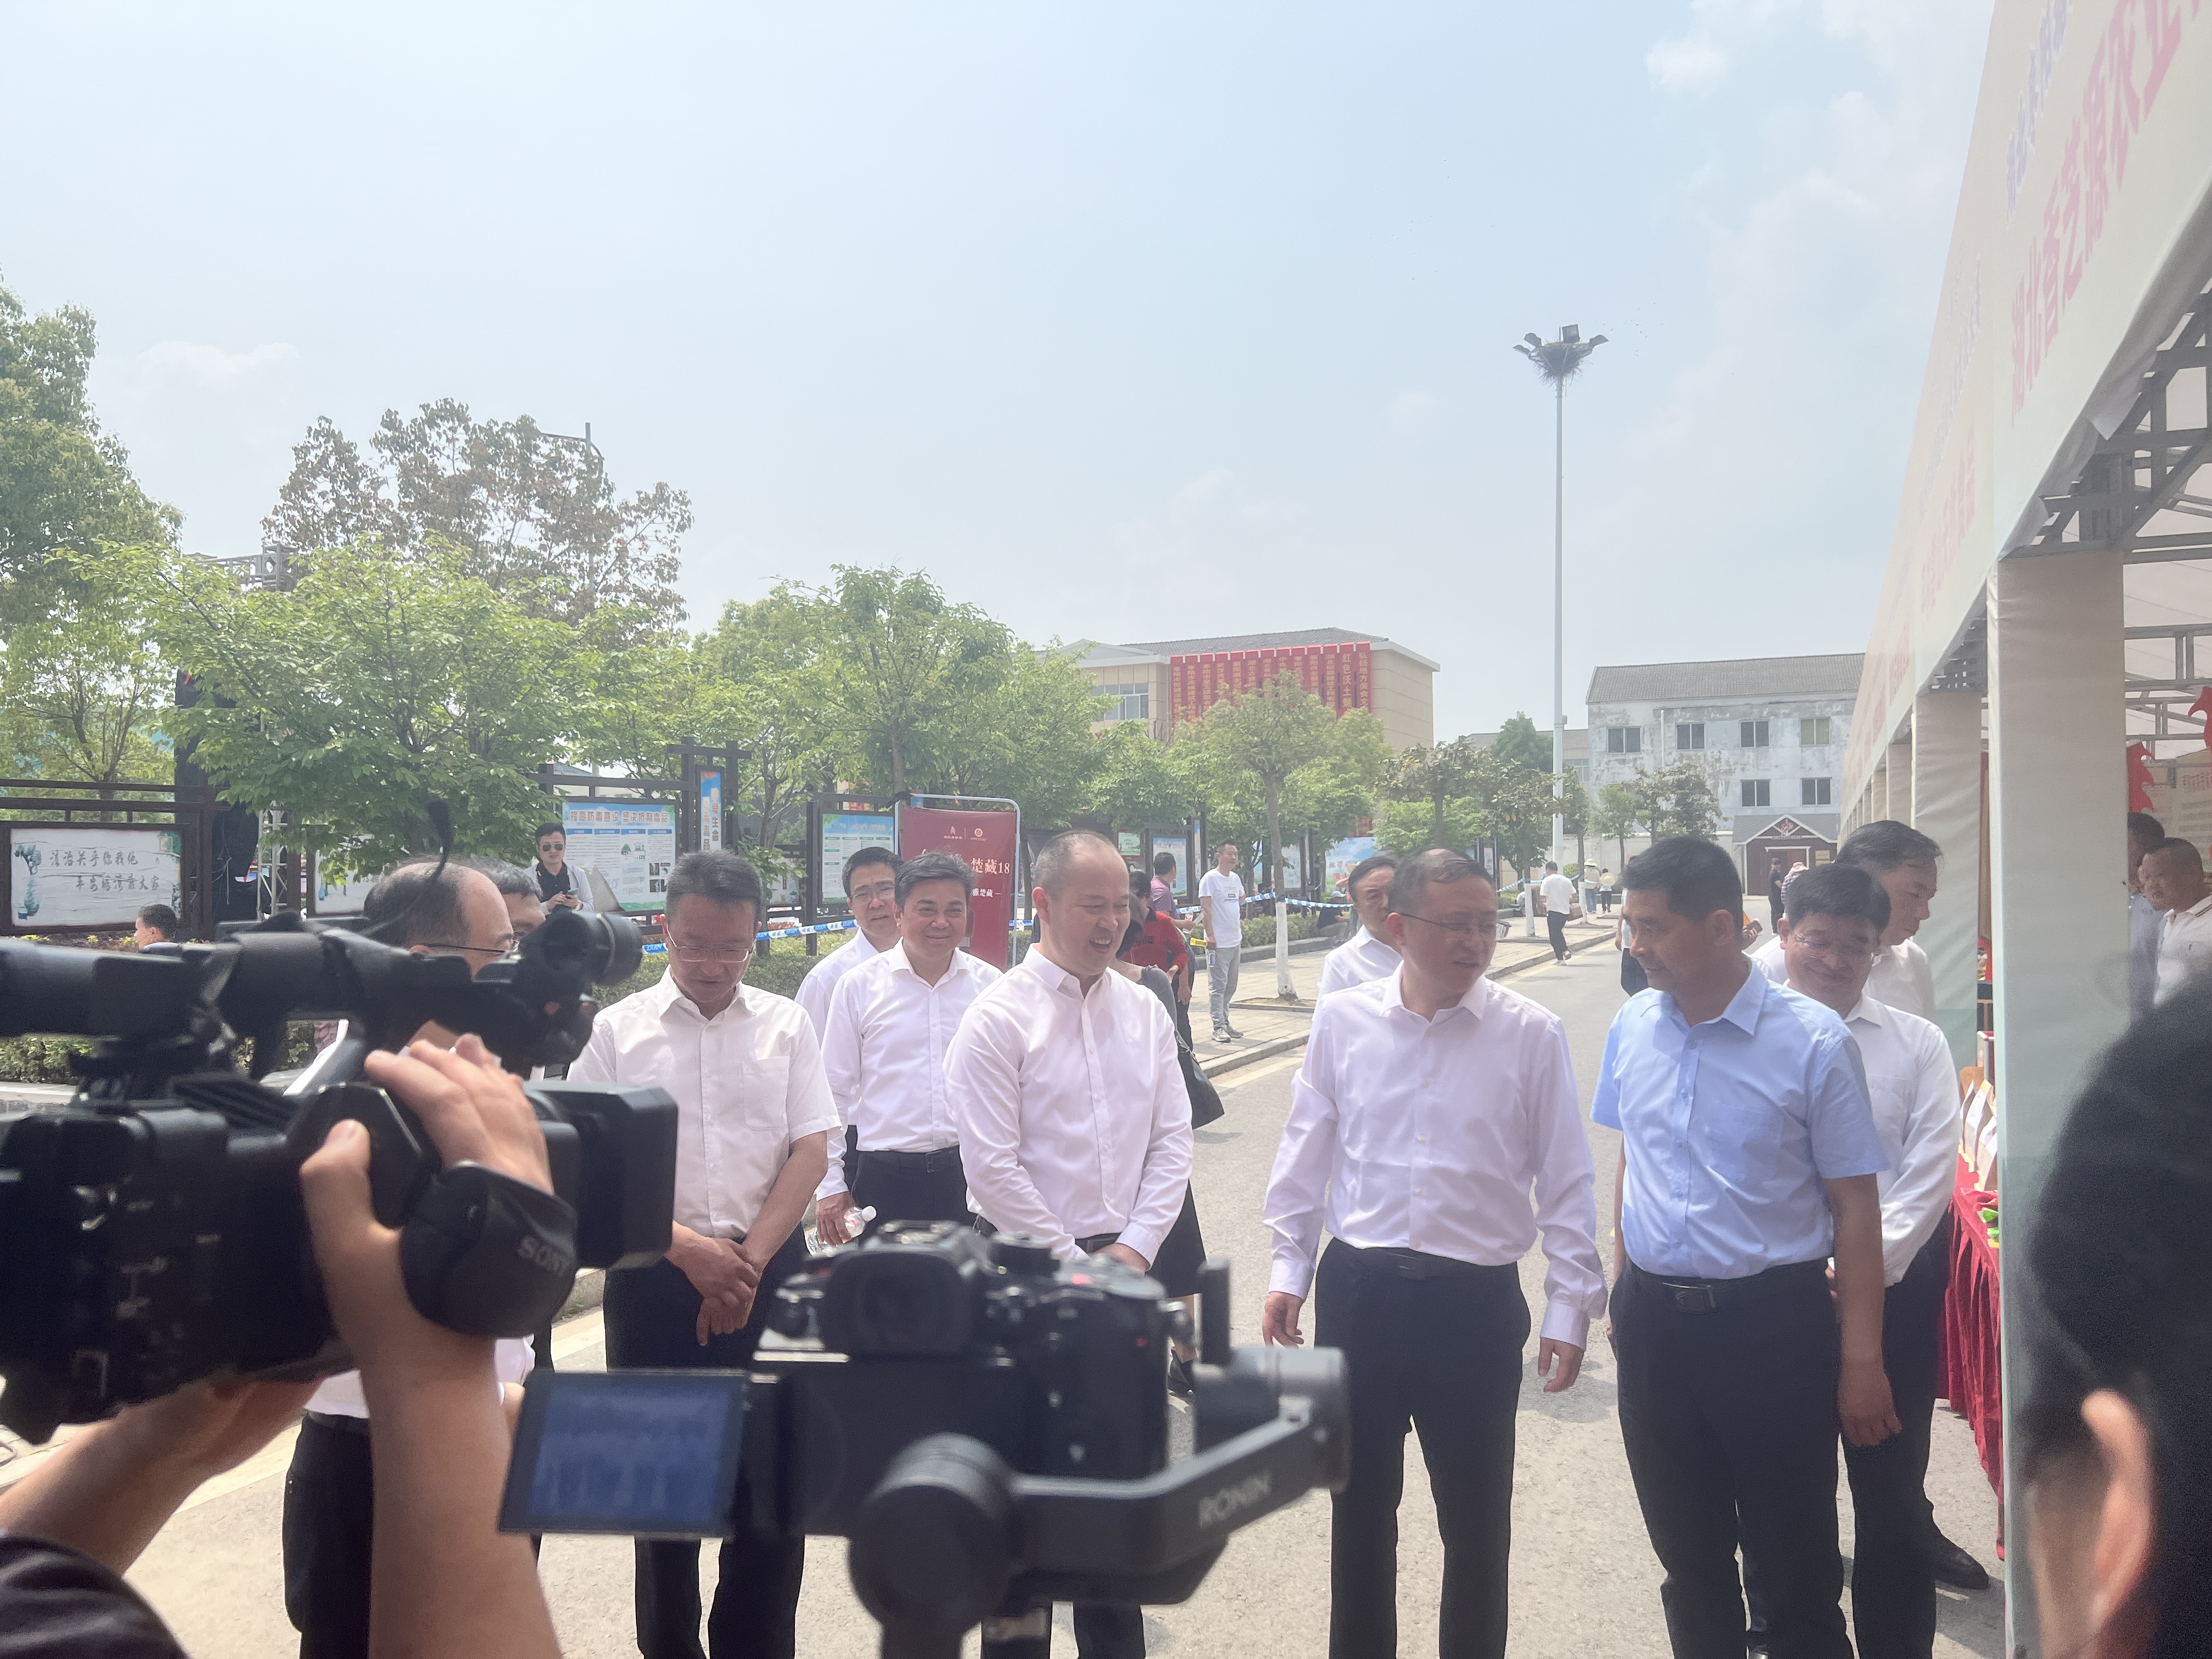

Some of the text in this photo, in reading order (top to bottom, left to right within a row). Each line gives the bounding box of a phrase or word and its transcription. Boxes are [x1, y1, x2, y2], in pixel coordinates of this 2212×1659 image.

[571, 810, 668, 823] 提高防毒意识 坚决抵制毒品
